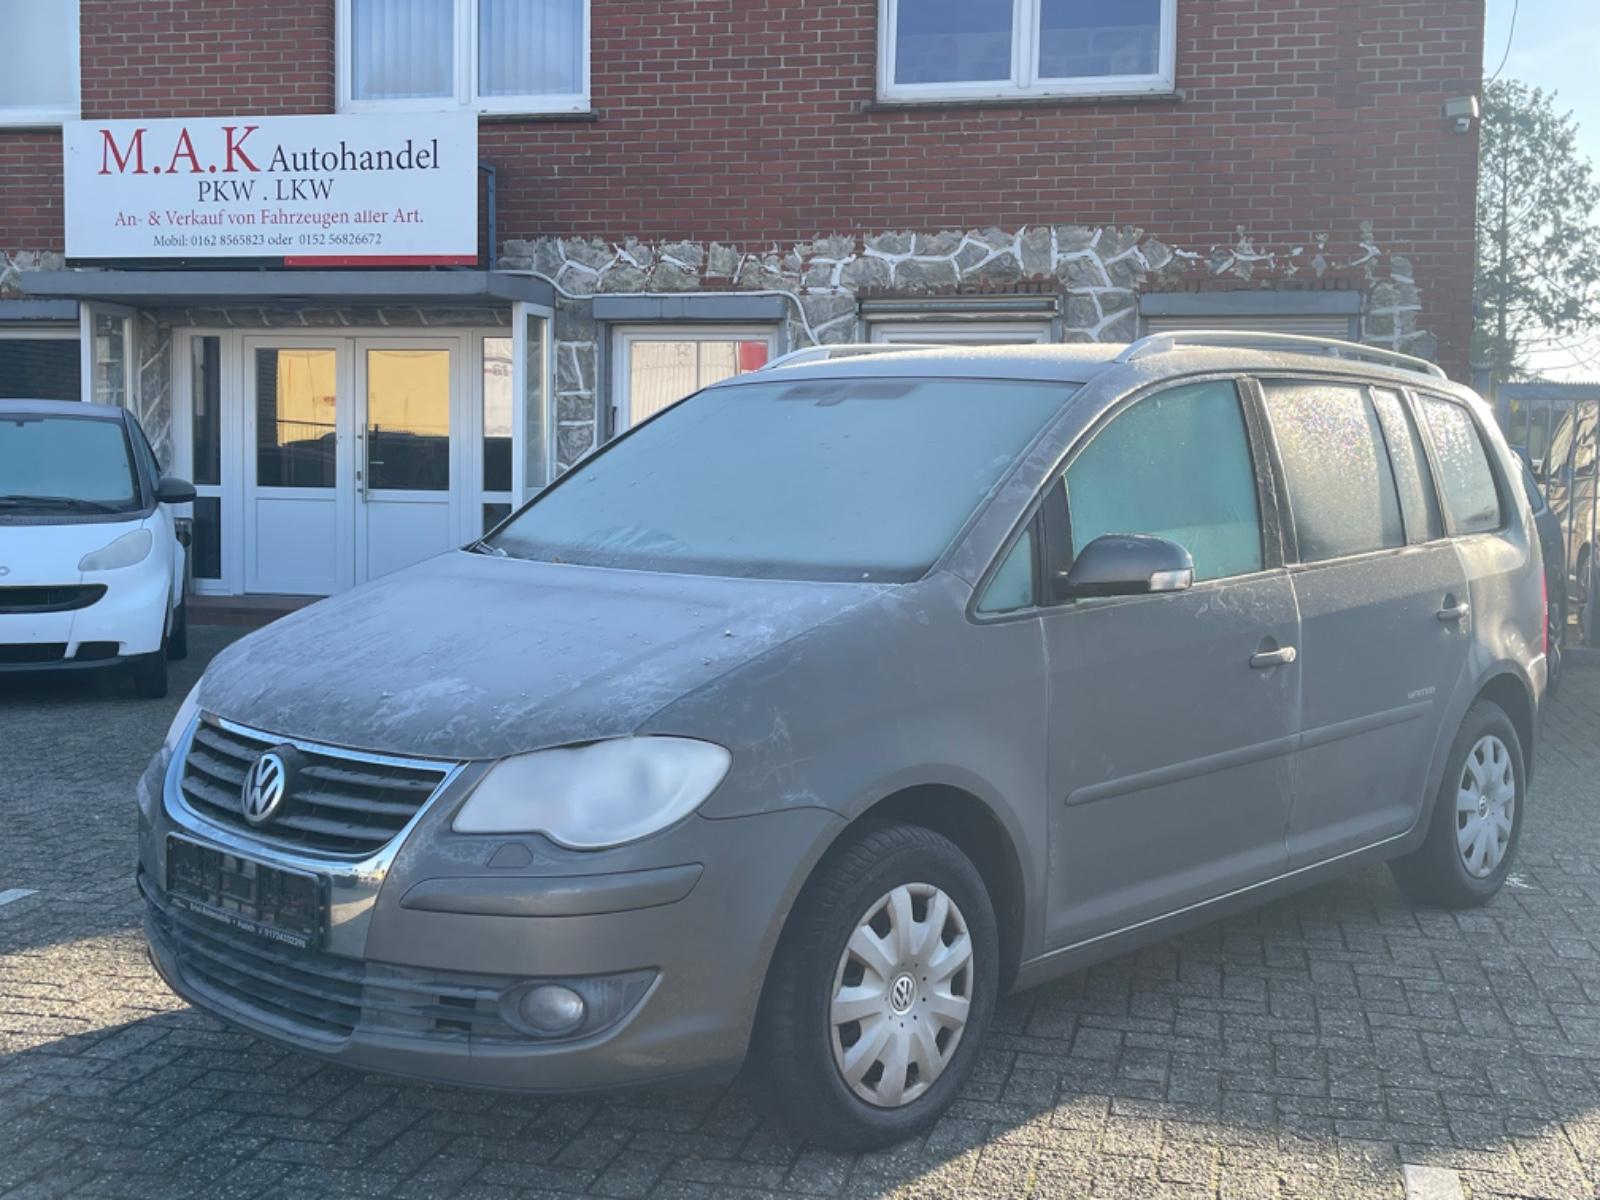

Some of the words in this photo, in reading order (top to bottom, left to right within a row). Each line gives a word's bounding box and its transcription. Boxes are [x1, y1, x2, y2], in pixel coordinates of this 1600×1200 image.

[98, 126, 261, 175] M.A.K
[267, 139, 440, 172] Autohandel
[198, 180, 255, 202] PKW
[276, 178, 334, 201] LKW
[115, 211, 142, 226] An-
[148, 211, 161, 226] &
[165, 209, 226, 226] Verkauf
[228, 212, 256, 225] von
[261, 208, 349, 229] Fahrzeugen
[354, 209, 389, 224] aller
[392, 207, 424, 224] Art.
[153, 234, 188, 247] Mobil:
[191, 234, 217, 247] 0162
[219, 234, 265, 246] 8565823
[267, 233, 294, 246] oder
[299, 233, 325, 246] 0152
